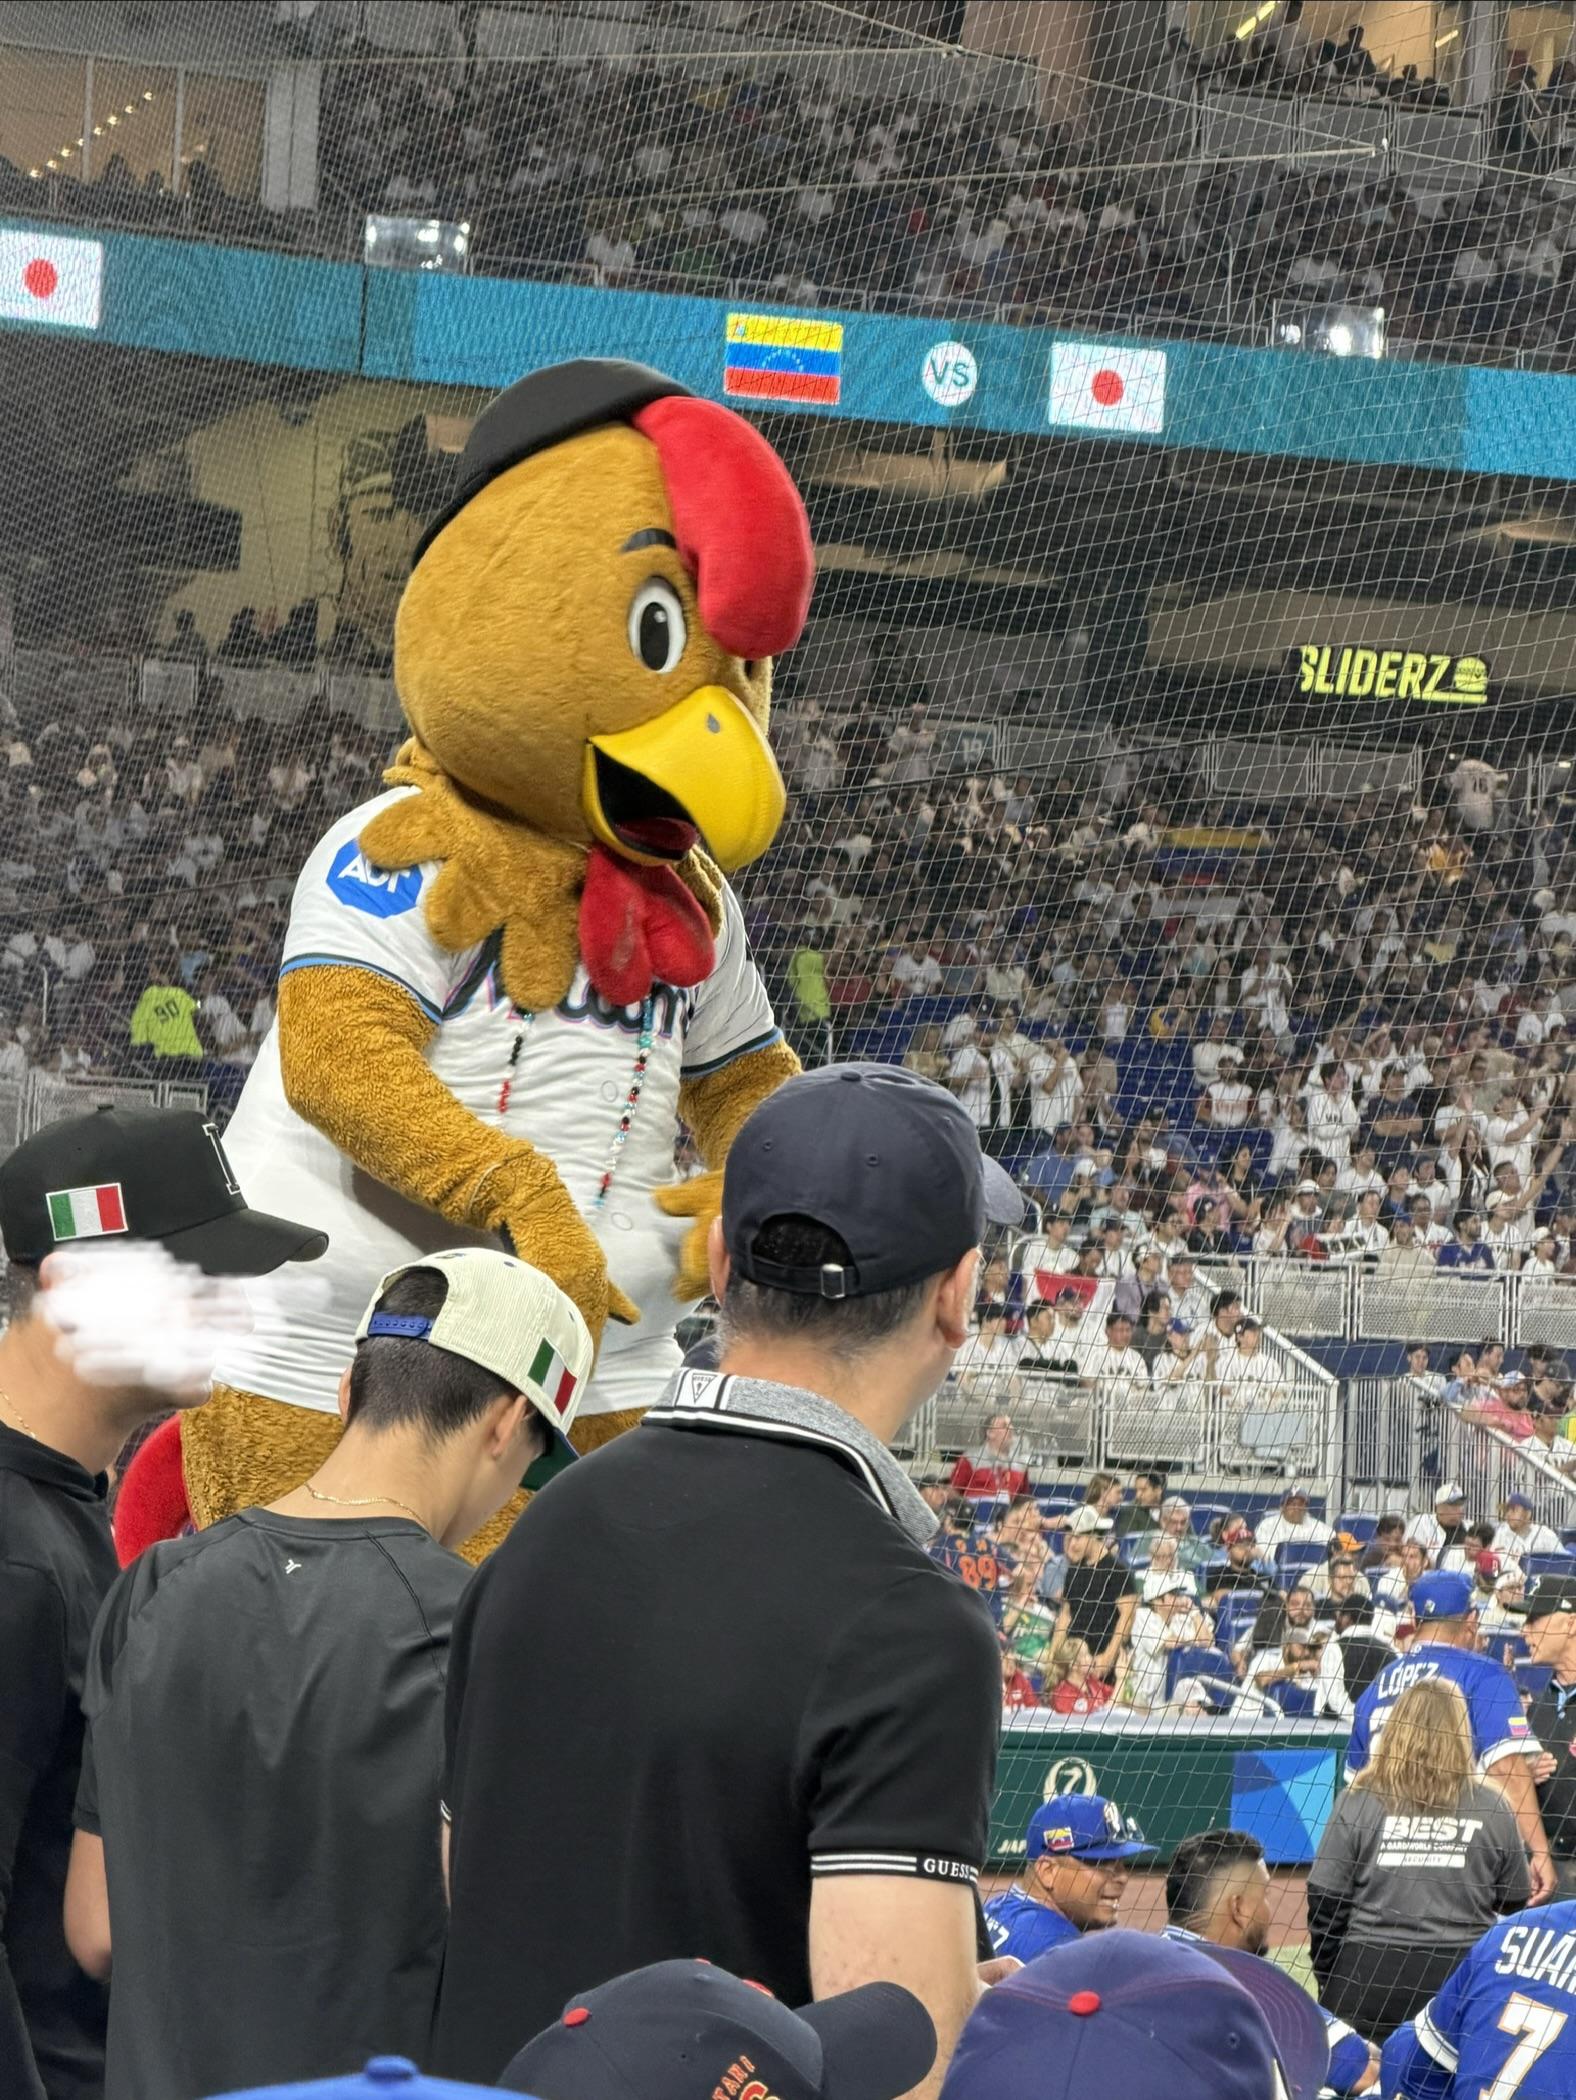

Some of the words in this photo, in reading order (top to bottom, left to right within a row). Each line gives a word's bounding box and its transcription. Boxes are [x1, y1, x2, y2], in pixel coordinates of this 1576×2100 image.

[931, 359, 969, 387] VS
[1300, 645, 1487, 704] SLIDERZ
[959, 1554, 997, 1591] 89
[1383, 1816, 1483, 1843] BEST
[997, 1839, 1027, 1854] JAP
[1479, 1991, 1569, 2100] 7
